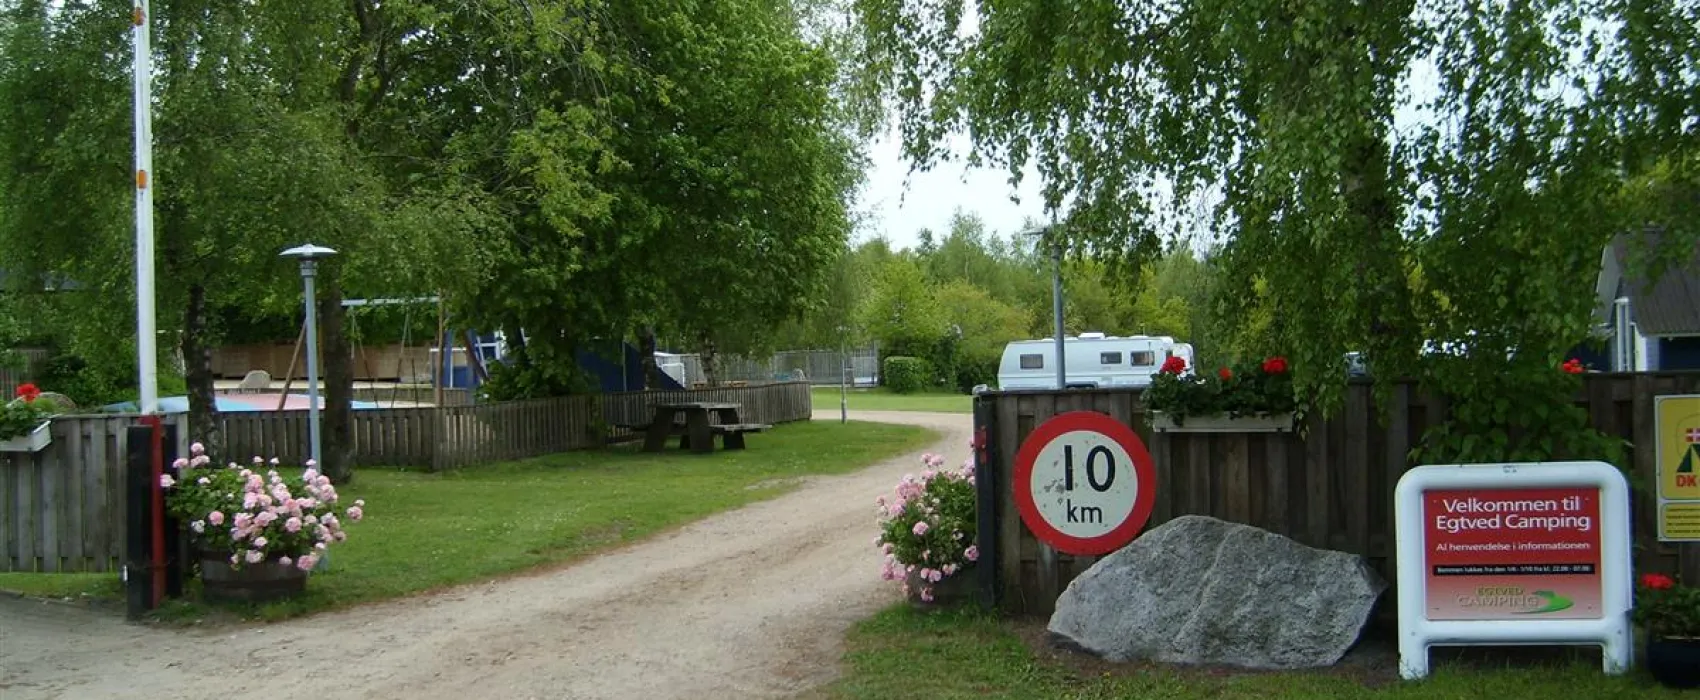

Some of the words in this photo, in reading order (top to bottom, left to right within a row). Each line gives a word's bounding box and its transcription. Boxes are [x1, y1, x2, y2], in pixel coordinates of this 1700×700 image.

[1065, 445, 1116, 492] 10
[1067, 499, 1103, 524] km
[1443, 498, 1557, 513] Velkommen
[1561, 495, 1581, 511] til
[1436, 514, 1500, 533] Egtved
[1505, 511, 1592, 532] Camping
[1436, 543, 1448, 552] Al
[1449, 541, 1511, 552] henvendelse
[1517, 540, 1590, 551] informationen
[1477, 586, 1524, 596] EGTVED
[1458, 595, 1540, 608] CAMPING
